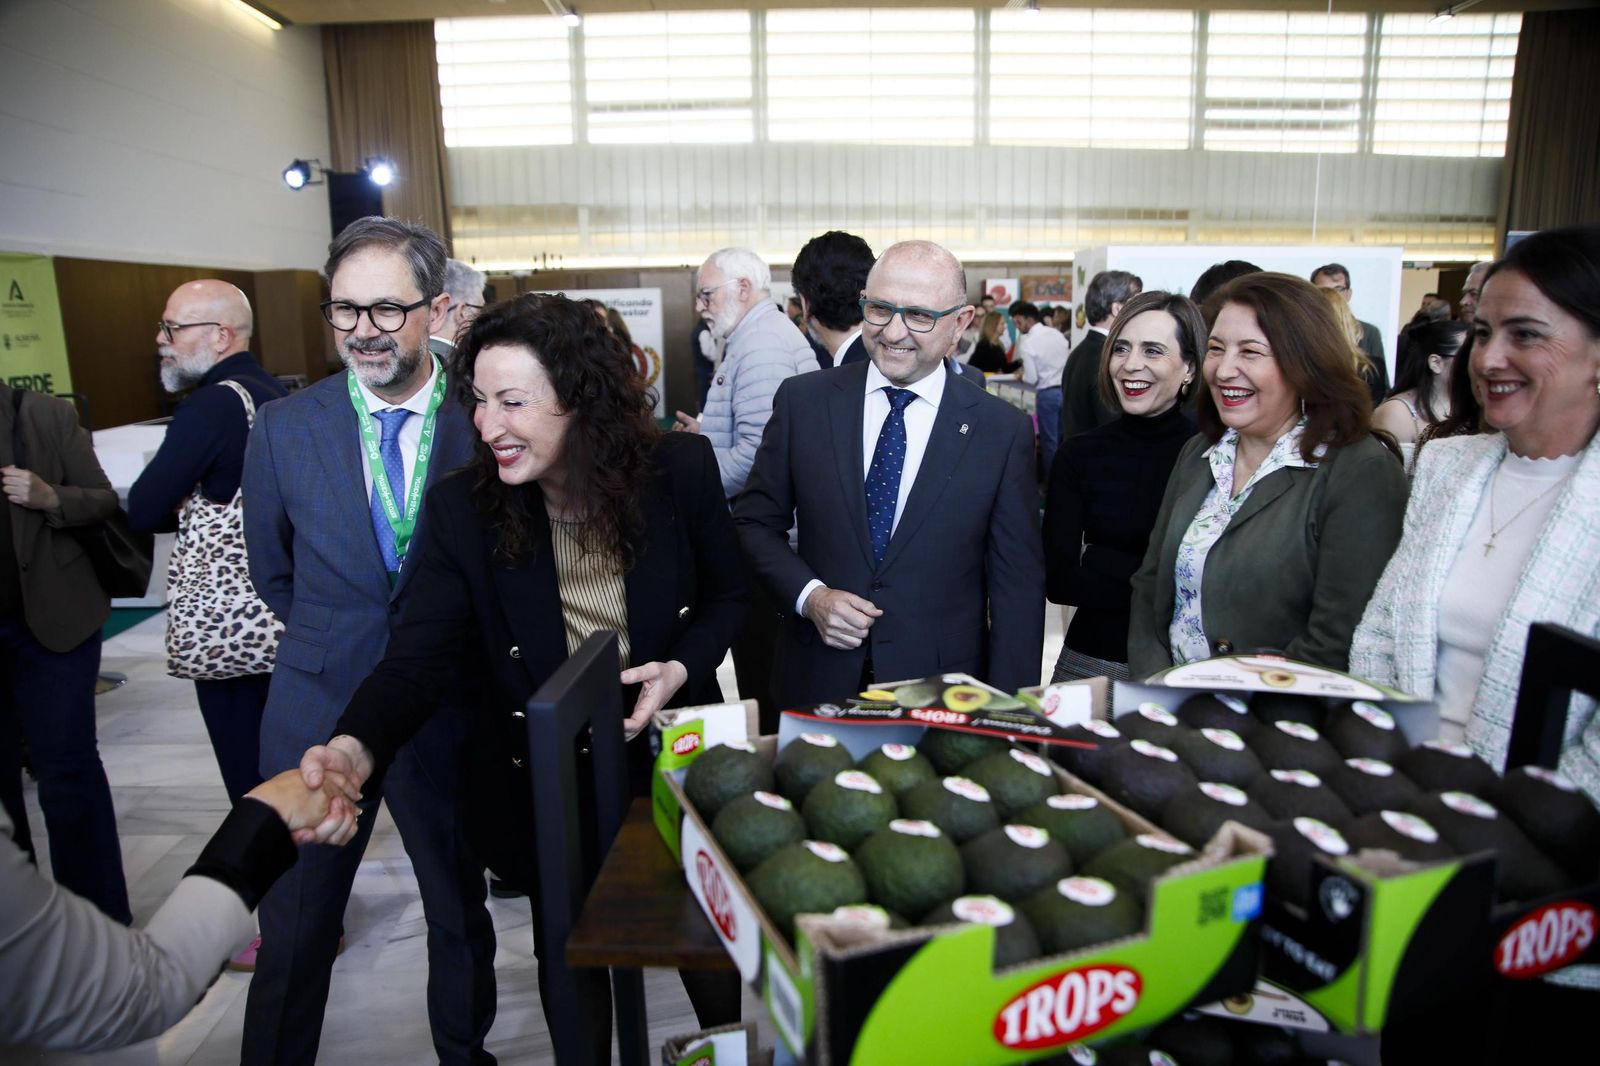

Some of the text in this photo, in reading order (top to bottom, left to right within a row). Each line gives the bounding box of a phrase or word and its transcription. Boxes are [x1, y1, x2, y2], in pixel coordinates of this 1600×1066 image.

[621, 308, 648, 317] estar
[1500, 906, 1594, 972] TROPS
[1000, 968, 1138, 1046] TROPS
